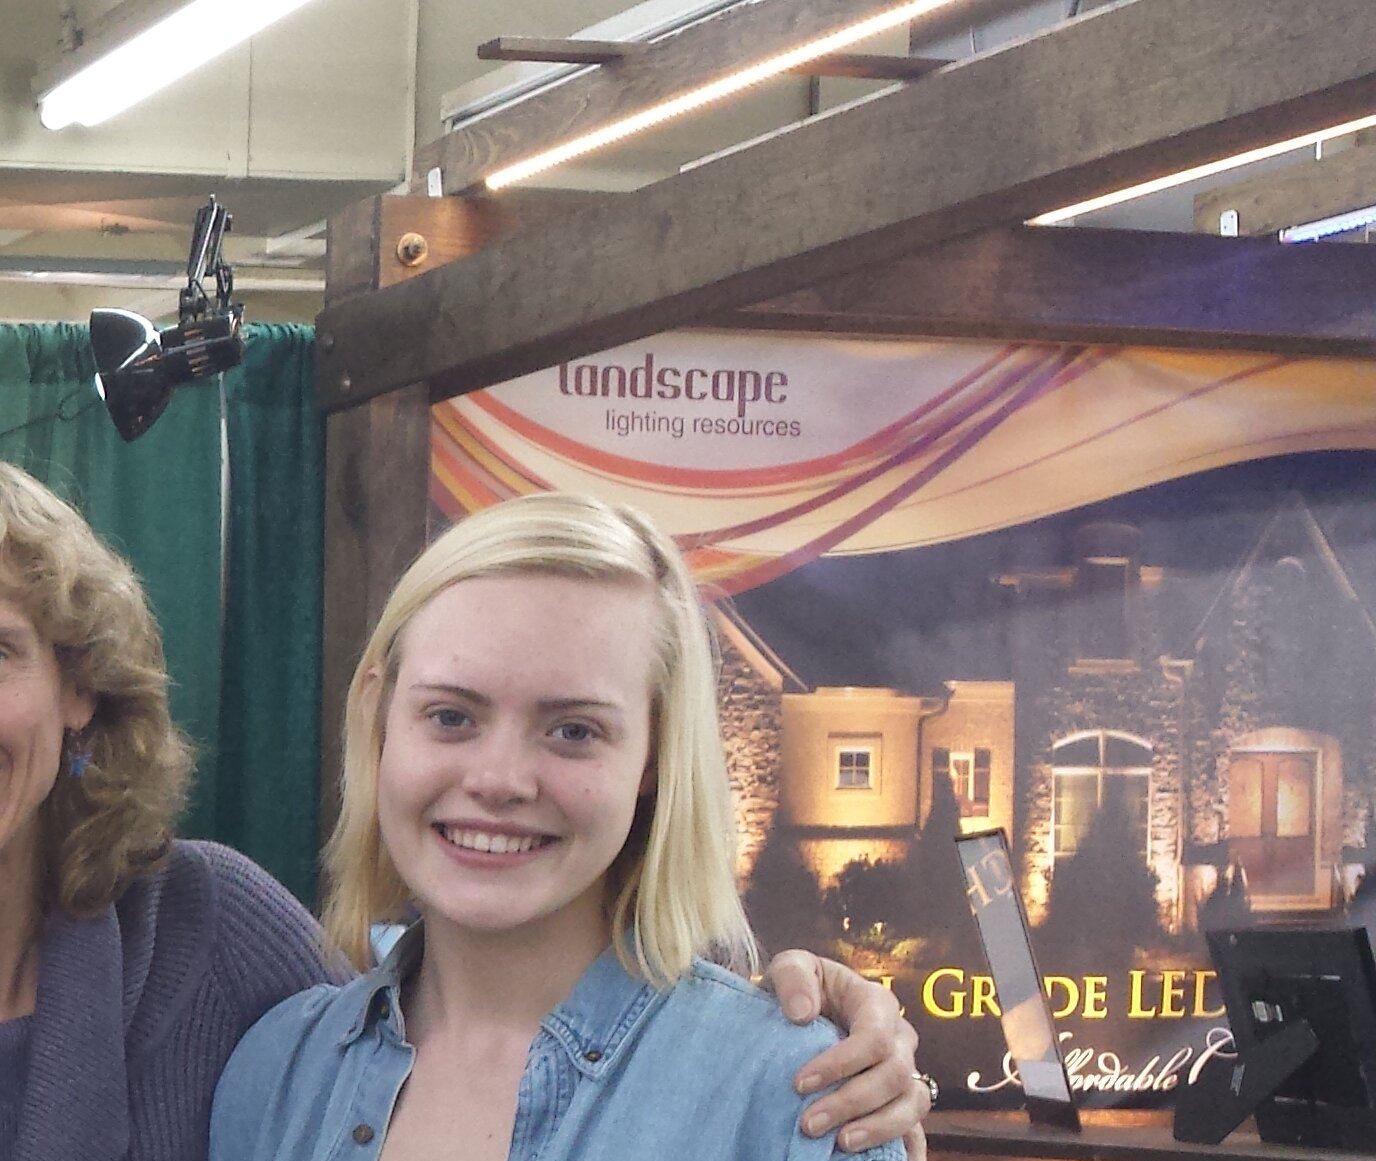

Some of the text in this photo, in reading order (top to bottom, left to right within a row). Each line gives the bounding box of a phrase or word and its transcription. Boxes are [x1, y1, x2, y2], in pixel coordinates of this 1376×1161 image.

[557, 351, 789, 418] landscape
[605, 408, 801, 438] lighting resources
[920, 966, 1110, 1020] GRDE
